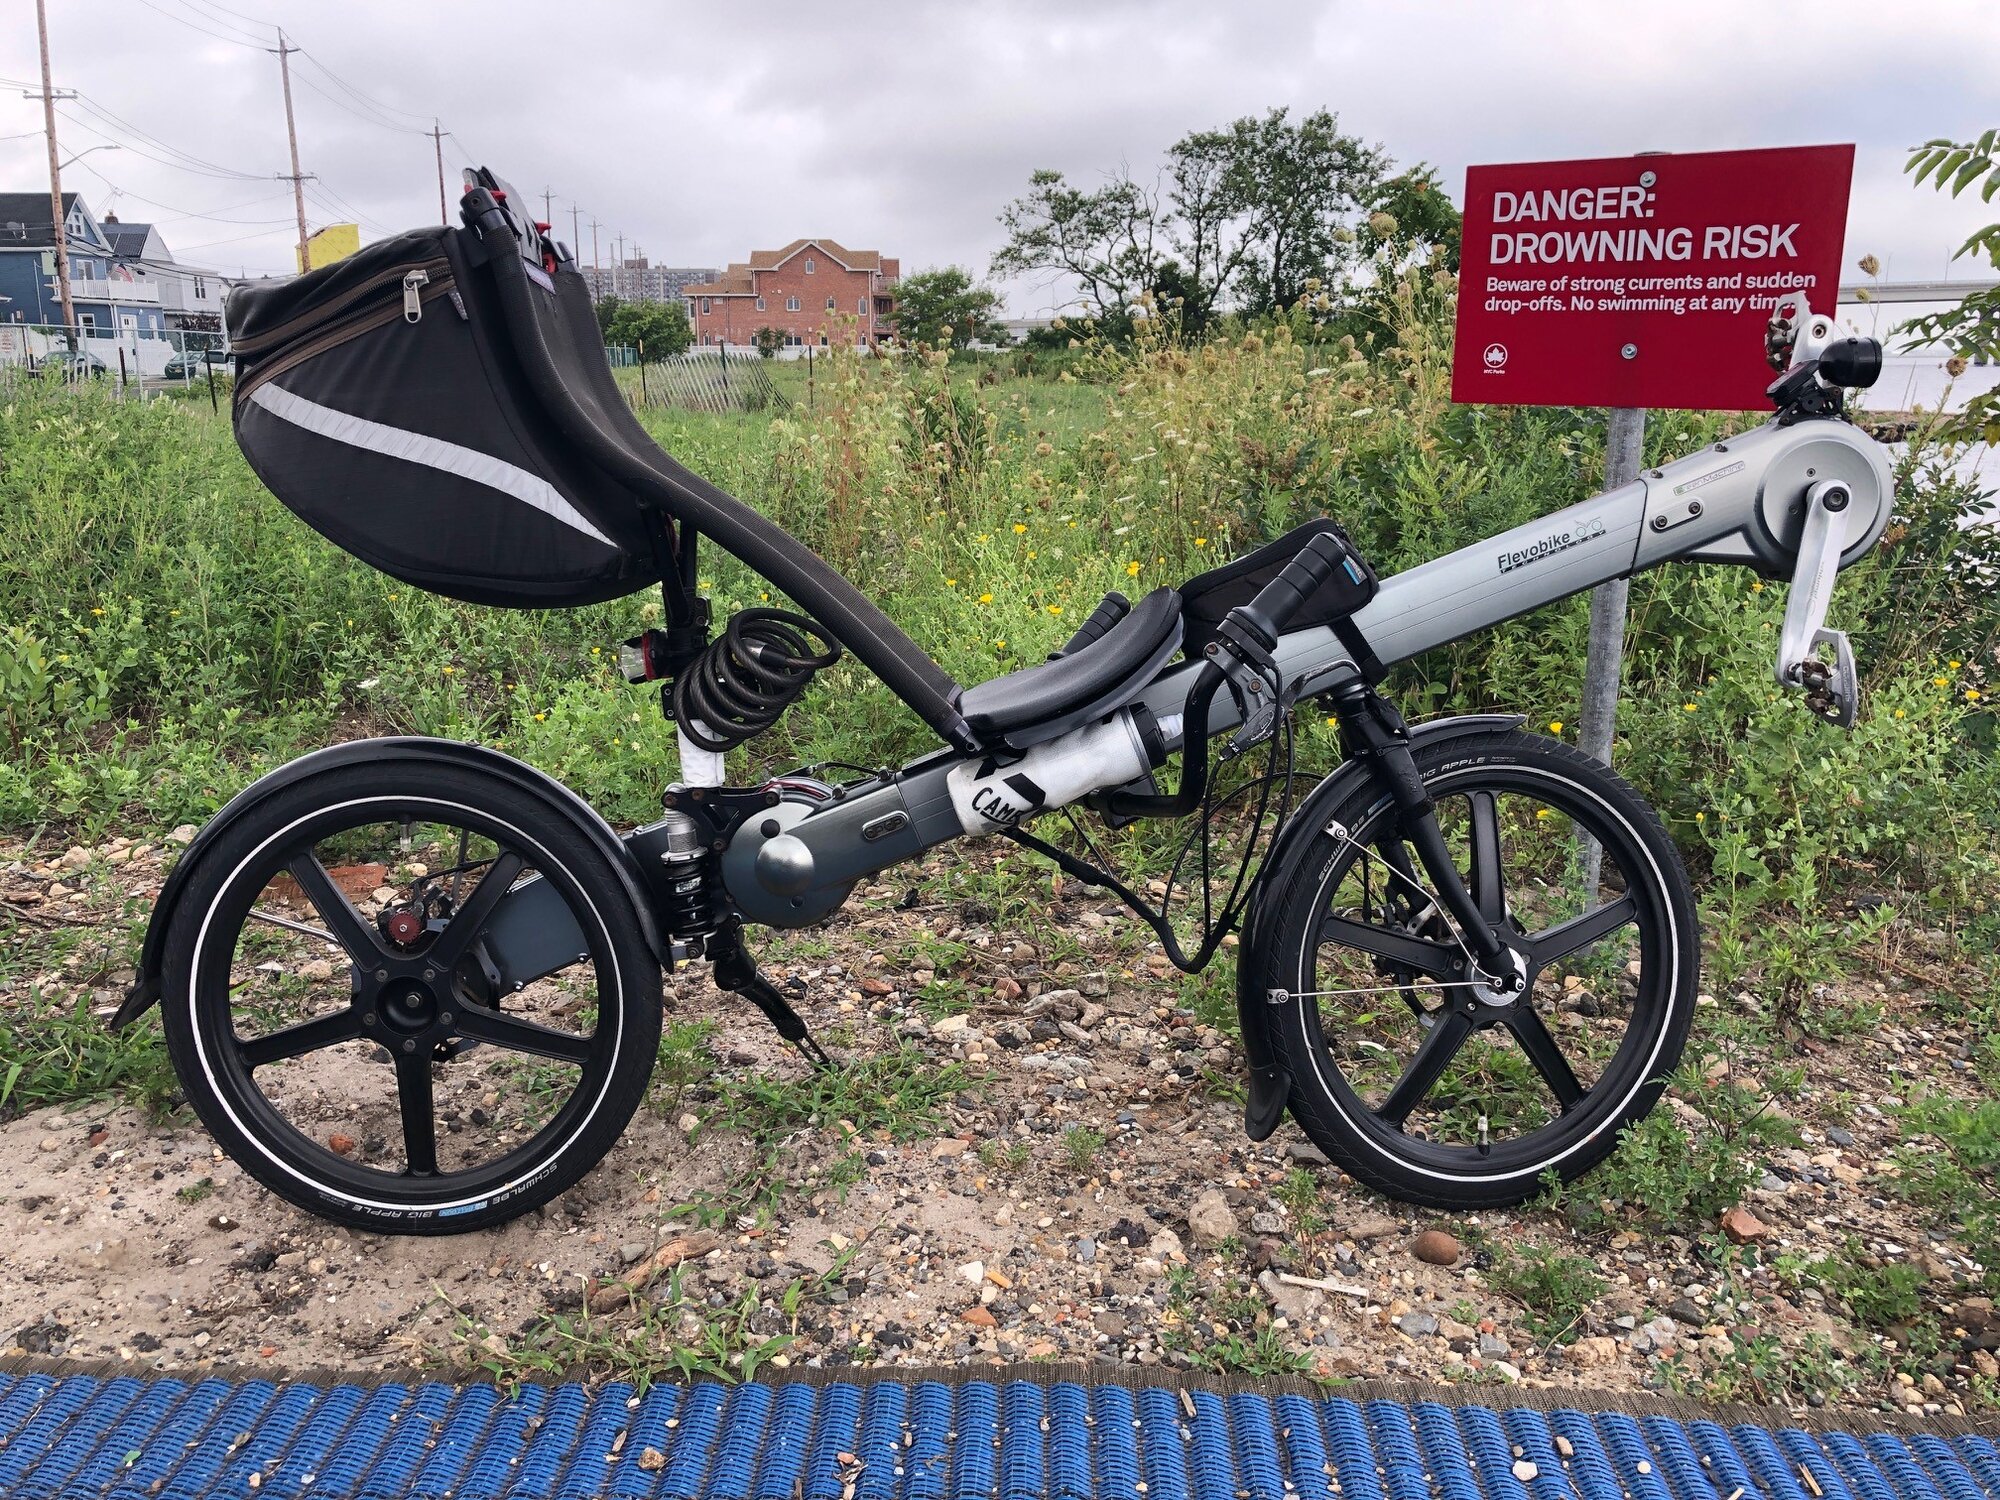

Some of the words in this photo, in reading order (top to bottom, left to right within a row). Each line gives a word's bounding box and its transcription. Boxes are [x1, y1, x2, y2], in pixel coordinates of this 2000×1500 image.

[1493, 187, 1656, 223] DANGER:
[1490, 228, 1692, 264] DROWNING
[1703, 224, 1801, 260] RISK
[1487, 277, 1546, 292] Beware
[1550, 276, 1568, 291] of
[1570, 276, 1625, 295] strong
[1628, 275, 1702, 291] currents
[1706, 273, 1742, 289] and
[1745, 272, 1816, 288] sudden
[1485, 296, 1566, 315] drop-offs.
[1571, 296, 1594, 311] No
[1598, 295, 1686, 315] swimming
[1689, 295, 1708, 310] at
[1711, 298, 1746, 314] any
[1497, 533, 1570, 568] Flevobike
[1441, 756, 1485, 772] APPLE
[1318, 815, 1365, 882] SCHWABE
[492, 1162, 558, 1205] SCHWALBE
[352, 1204, 402, 1218] APPLE
